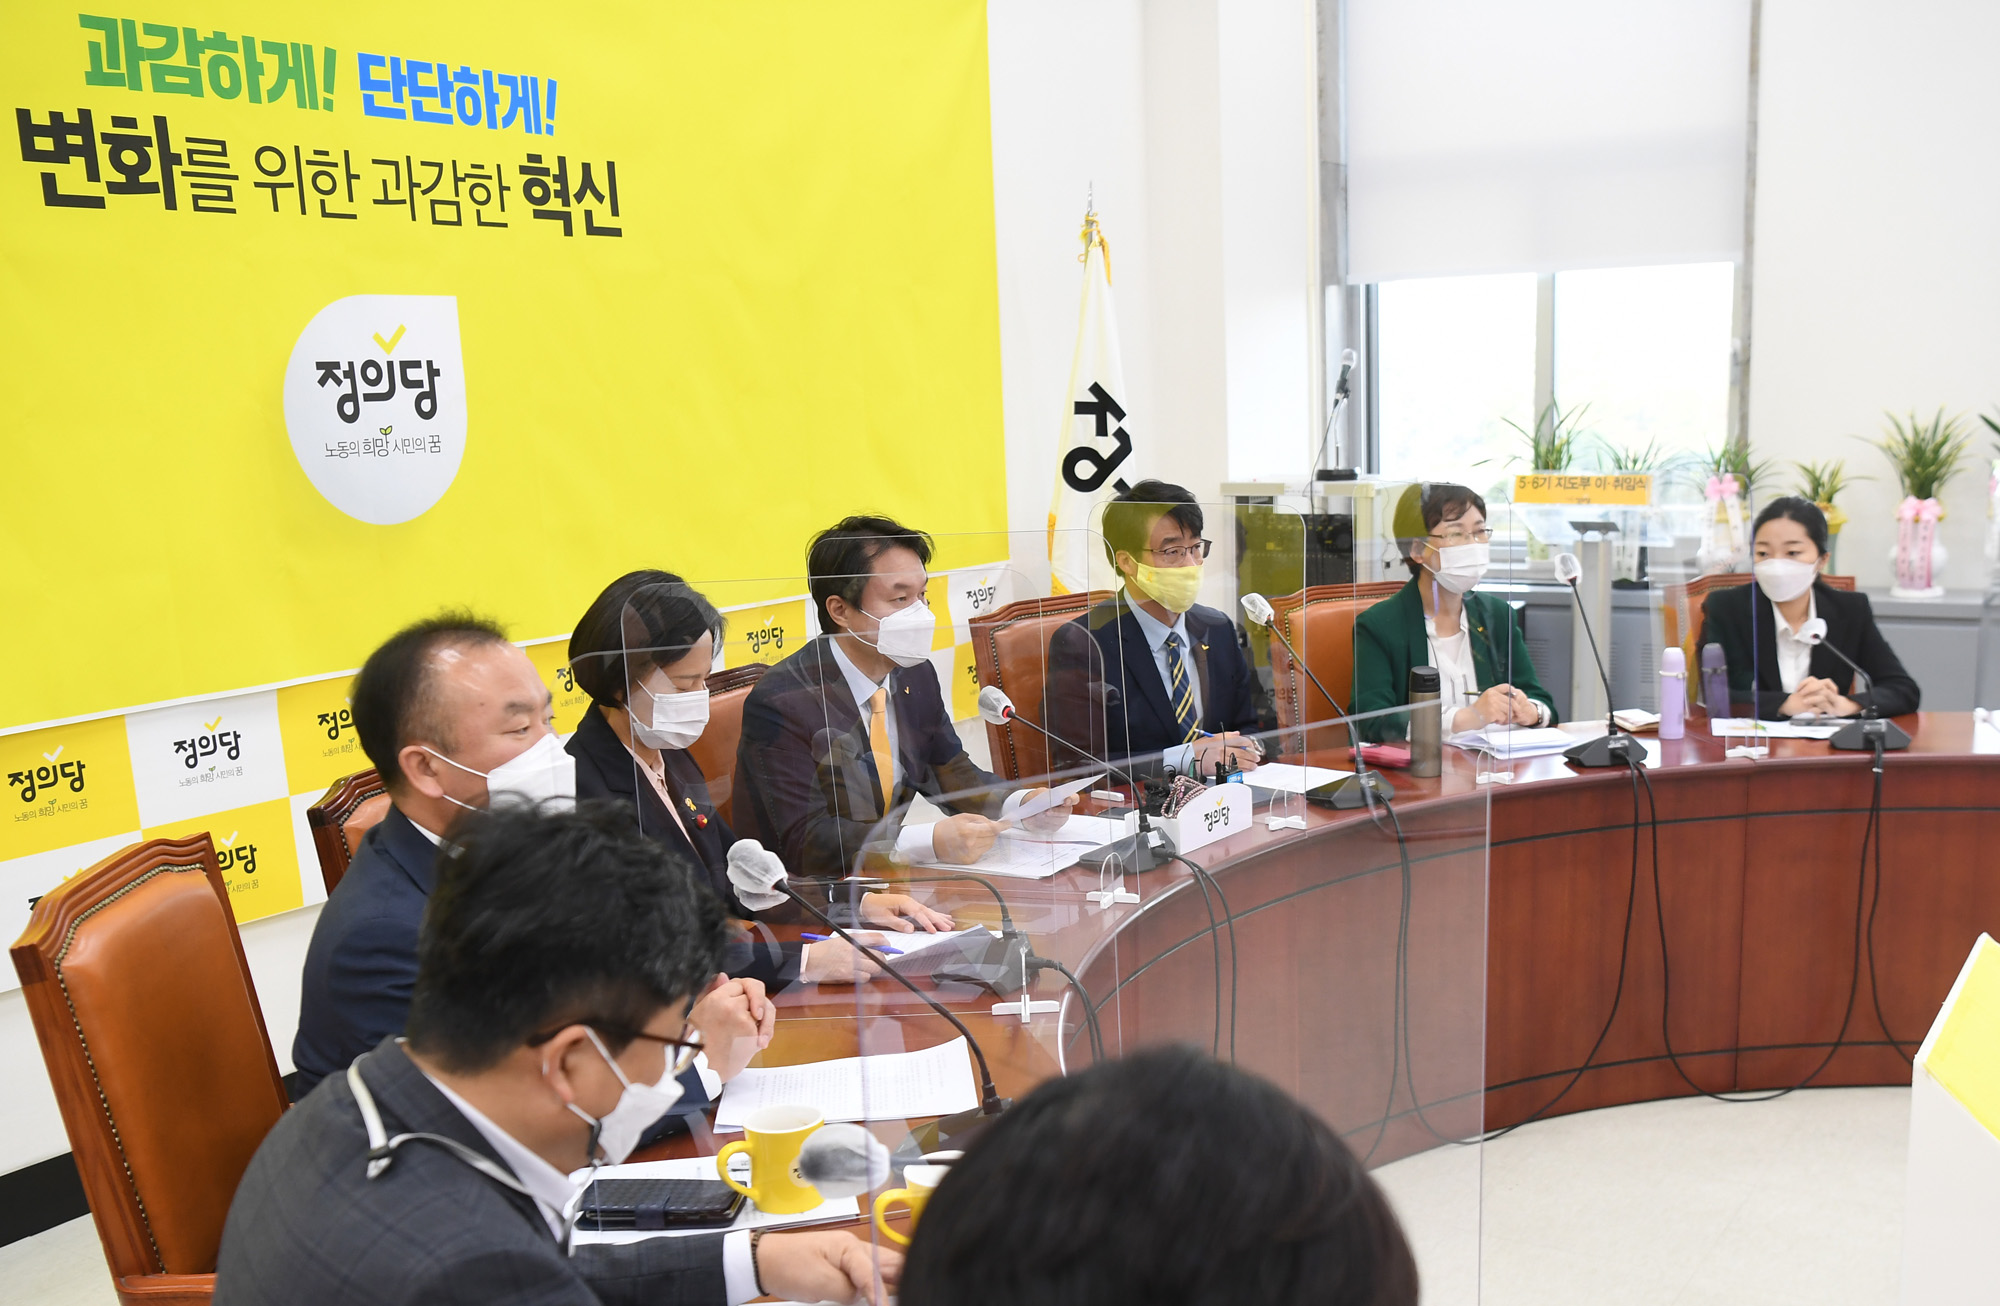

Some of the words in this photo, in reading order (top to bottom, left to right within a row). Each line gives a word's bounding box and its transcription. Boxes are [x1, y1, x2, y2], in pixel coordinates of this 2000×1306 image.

[79, 13, 337, 112] 과감하게!
[357, 52, 558, 136] 단단하게!
[15, 107, 240, 215] 변화를
[253, 144, 361, 220] 위한
[371, 155, 511, 229] 과감한
[518, 152, 623, 238] 혁신
[315, 359, 440, 424] 정의당
[325, 440, 360, 459] 노동의
[362, 436, 390, 457] 희망
[393, 437, 426, 454] 시민의
[428, 434, 441, 454] 꿈
[1555, 476, 1591, 490] 지도부
[746, 626, 784, 654] 정의당
[173, 730, 241, 769] 정의당
[8, 760, 86, 802] 정의당
[1204, 806, 1230, 832] 정의당
[217, 844, 257, 874] 의당
